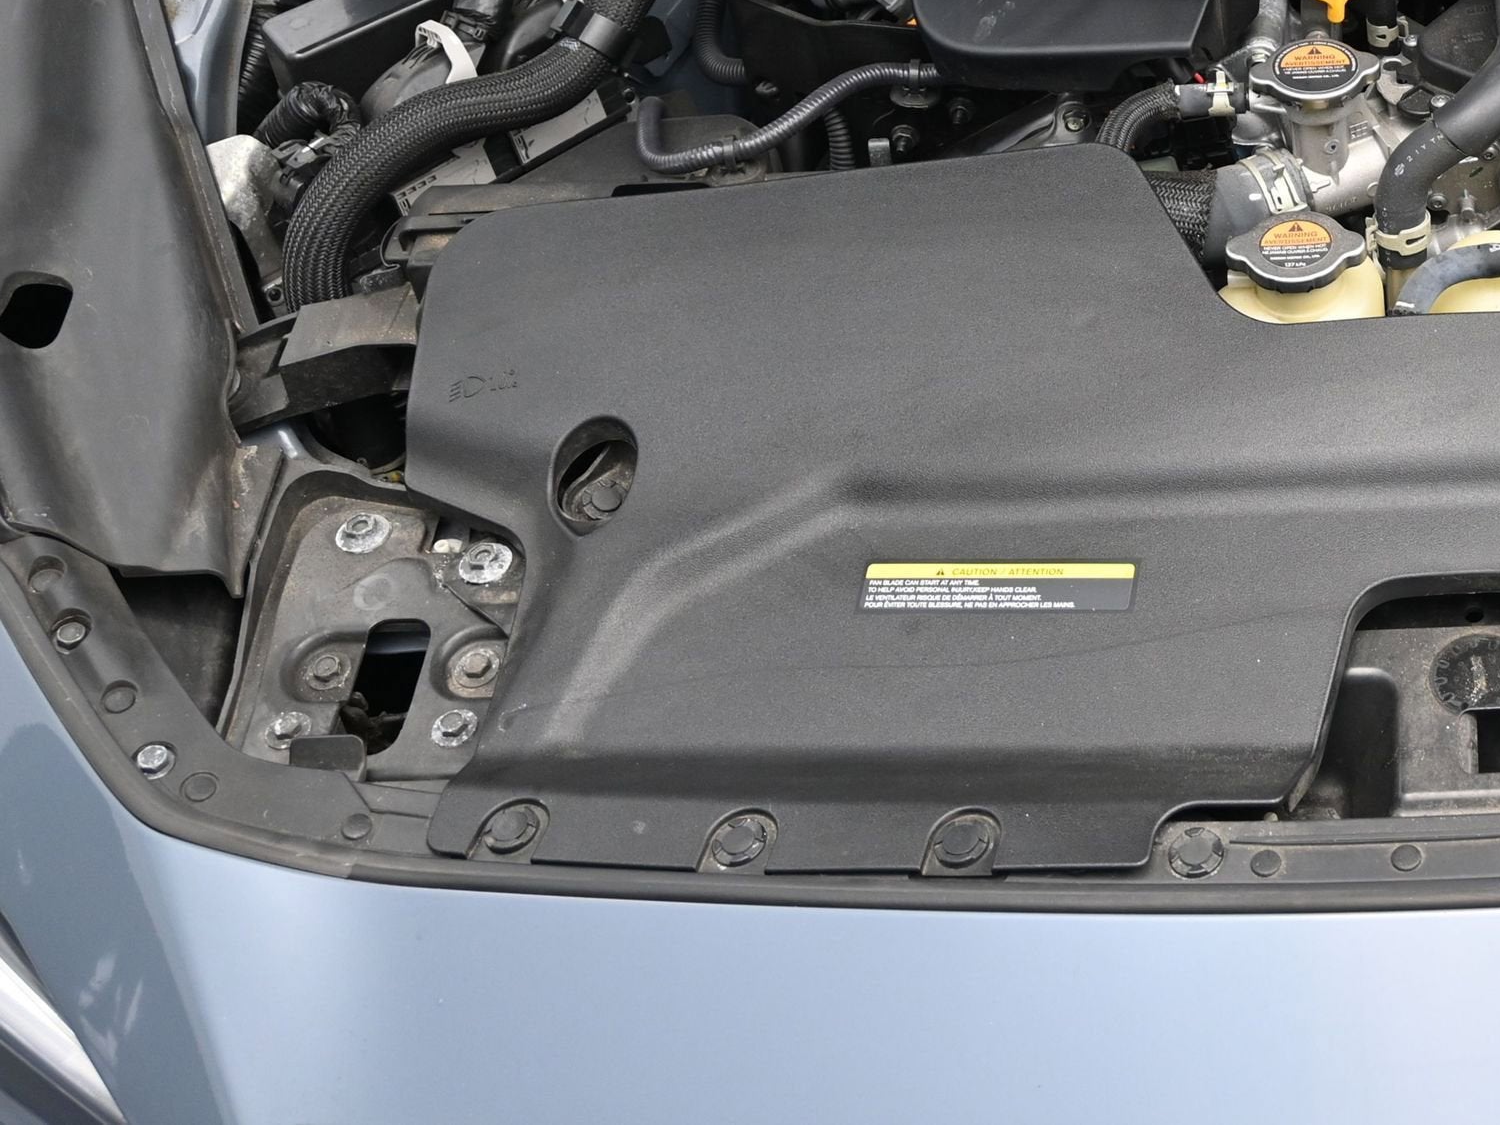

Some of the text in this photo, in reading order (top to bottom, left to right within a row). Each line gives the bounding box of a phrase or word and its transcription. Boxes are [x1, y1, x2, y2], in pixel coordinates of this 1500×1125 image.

[1273, 231, 1319, 239] WARNING
[951, 567, 998, 576] CAUTION
[1008, 567, 1064, 576] ATTENTION
